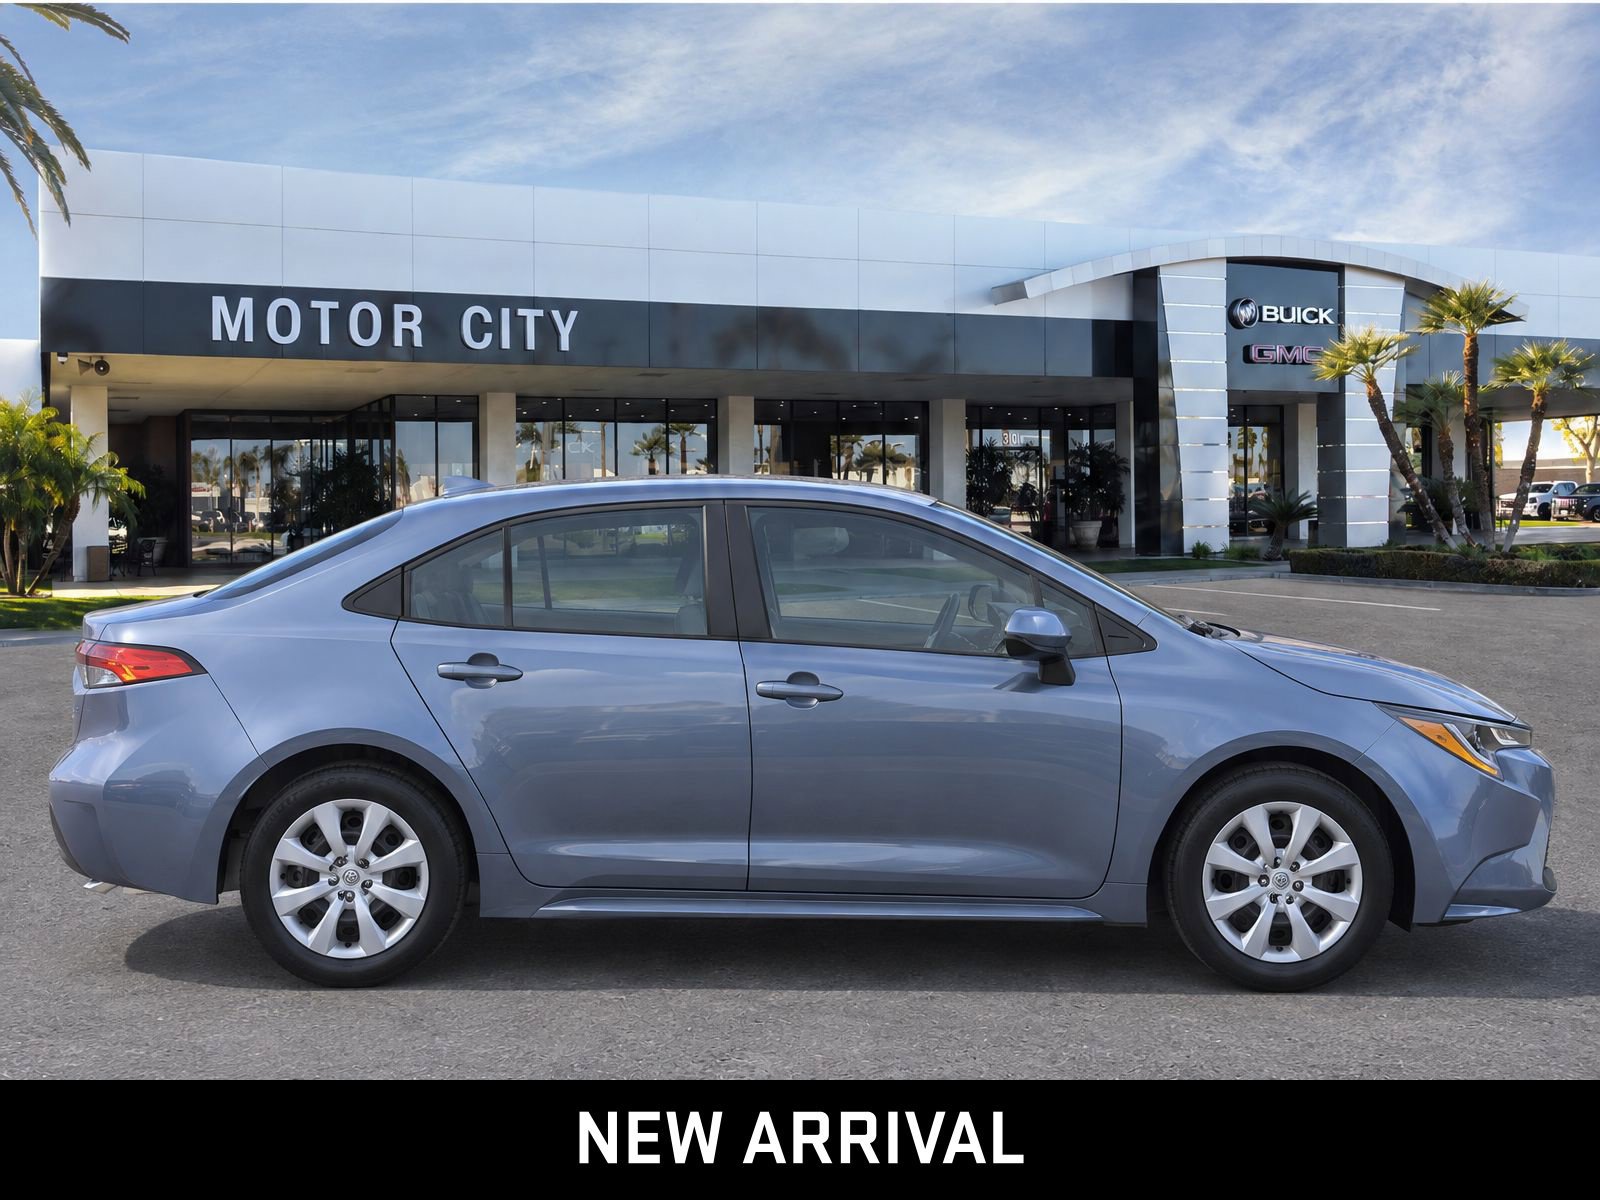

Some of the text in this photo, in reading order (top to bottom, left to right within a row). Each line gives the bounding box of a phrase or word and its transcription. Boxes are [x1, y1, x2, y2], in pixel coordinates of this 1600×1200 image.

[211, 295, 579, 351] MOTOR CITY
[1263, 306, 1334, 324] BUICK
[1251, 344, 1325, 364] GMC
